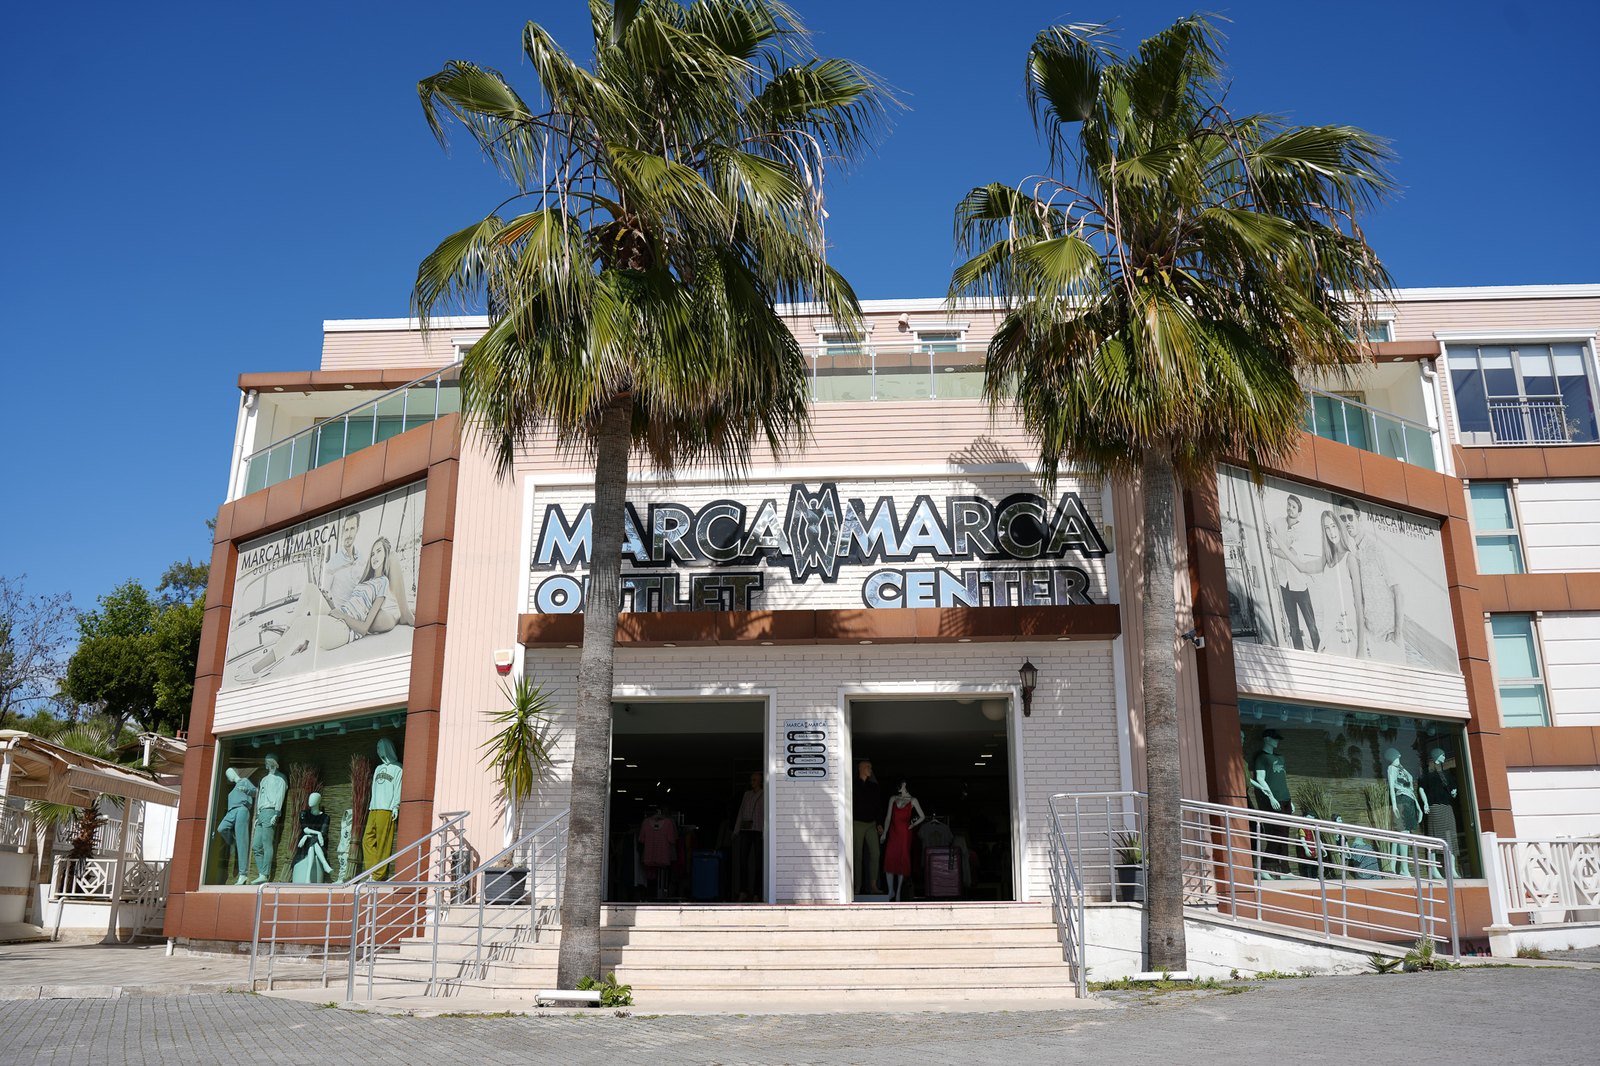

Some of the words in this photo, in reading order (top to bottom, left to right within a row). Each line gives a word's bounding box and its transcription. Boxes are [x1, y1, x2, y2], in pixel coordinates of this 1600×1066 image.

[241, 544, 281, 570] MARCA
[294, 524, 337, 551] MARCA
[837, 491, 1112, 564] MARCA
[1367, 512, 1397, 527] MARCA
[1406, 522, 1434, 536] MARCA
[253, 560, 280, 575] OUTLET
[534, 572, 764, 613] OTLET
[861, 566, 1097, 609] CENTER
